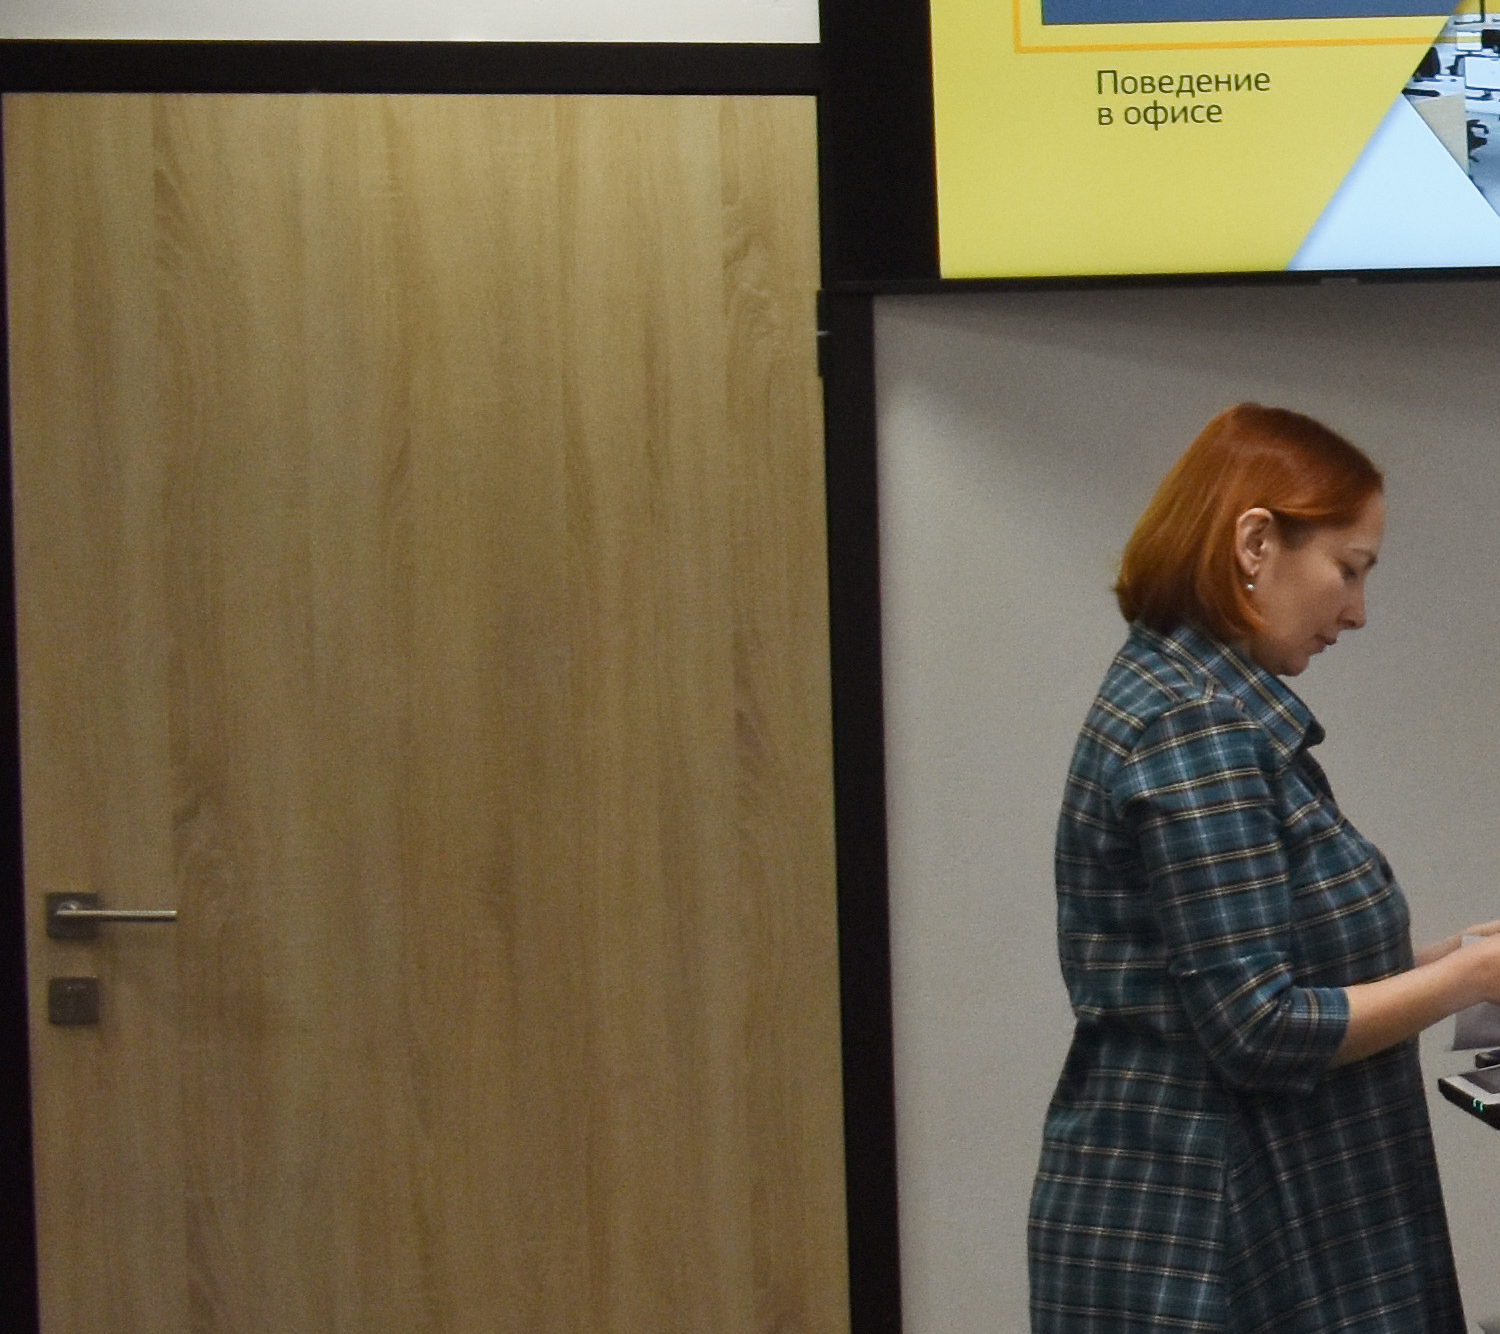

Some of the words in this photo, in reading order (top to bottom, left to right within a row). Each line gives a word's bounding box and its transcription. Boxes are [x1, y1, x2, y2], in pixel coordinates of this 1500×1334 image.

[1096, 67, 1271, 97] Поведение
[1098, 105, 1115, 125] в
[1124, 98, 1224, 133] офисе
